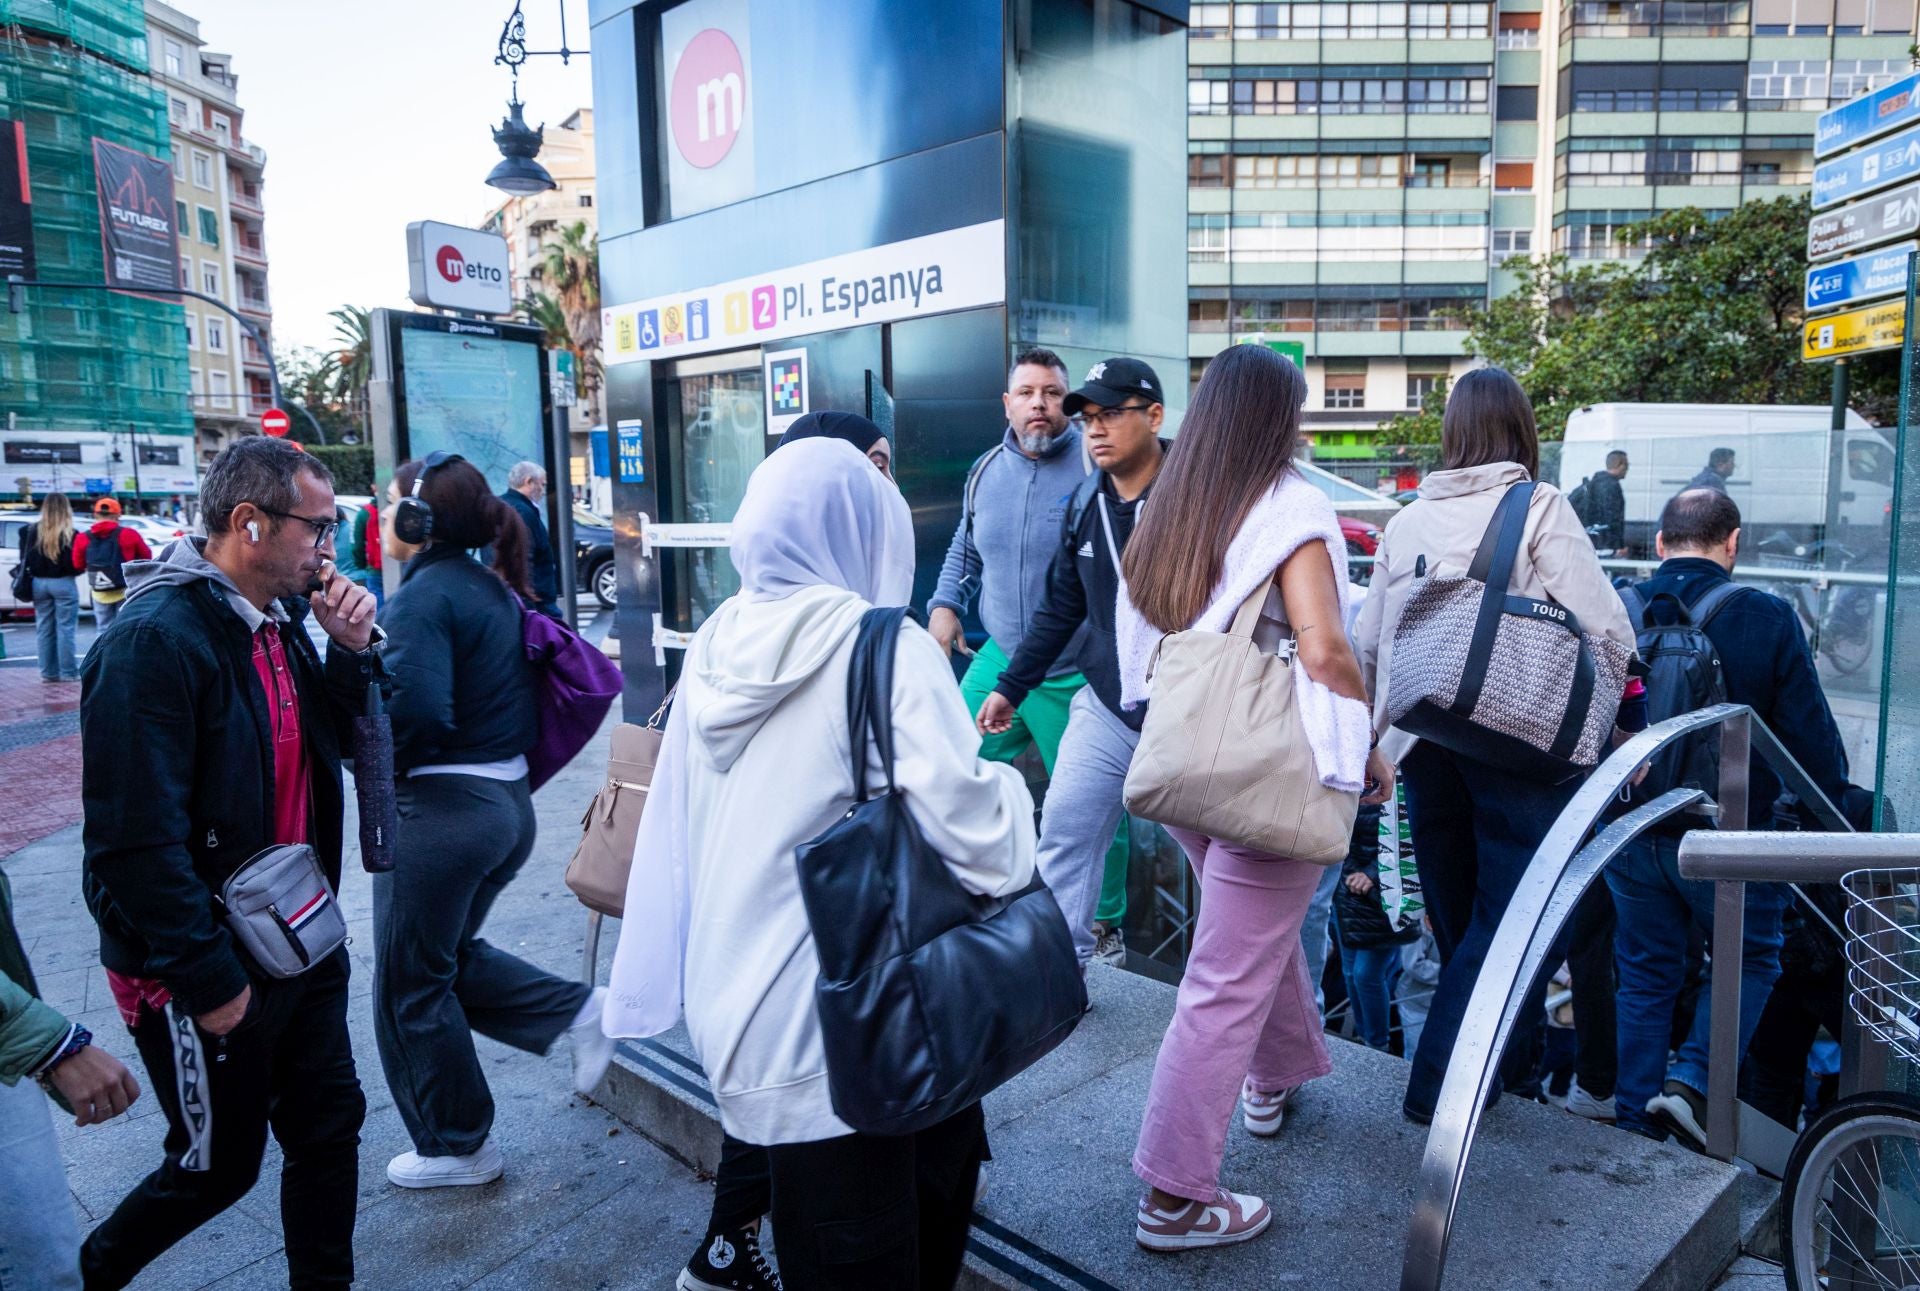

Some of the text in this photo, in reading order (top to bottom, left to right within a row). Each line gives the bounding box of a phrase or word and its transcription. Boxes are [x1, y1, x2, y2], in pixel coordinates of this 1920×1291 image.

[697, 72, 742, 142] m
[110, 206, 169, 233] FUTUREX
[1813, 214, 1856, 238] Palau de
[1811, 228, 1865, 254] Congressos
[446, 258, 502, 282] metro
[757, 291, 772, 324] 2
[783, 282, 812, 321] Pl.
[821, 264, 943, 319] Espanya
[460, 324, 495, 335] promedios
[1532, 602, 1566, 621] TOUS
